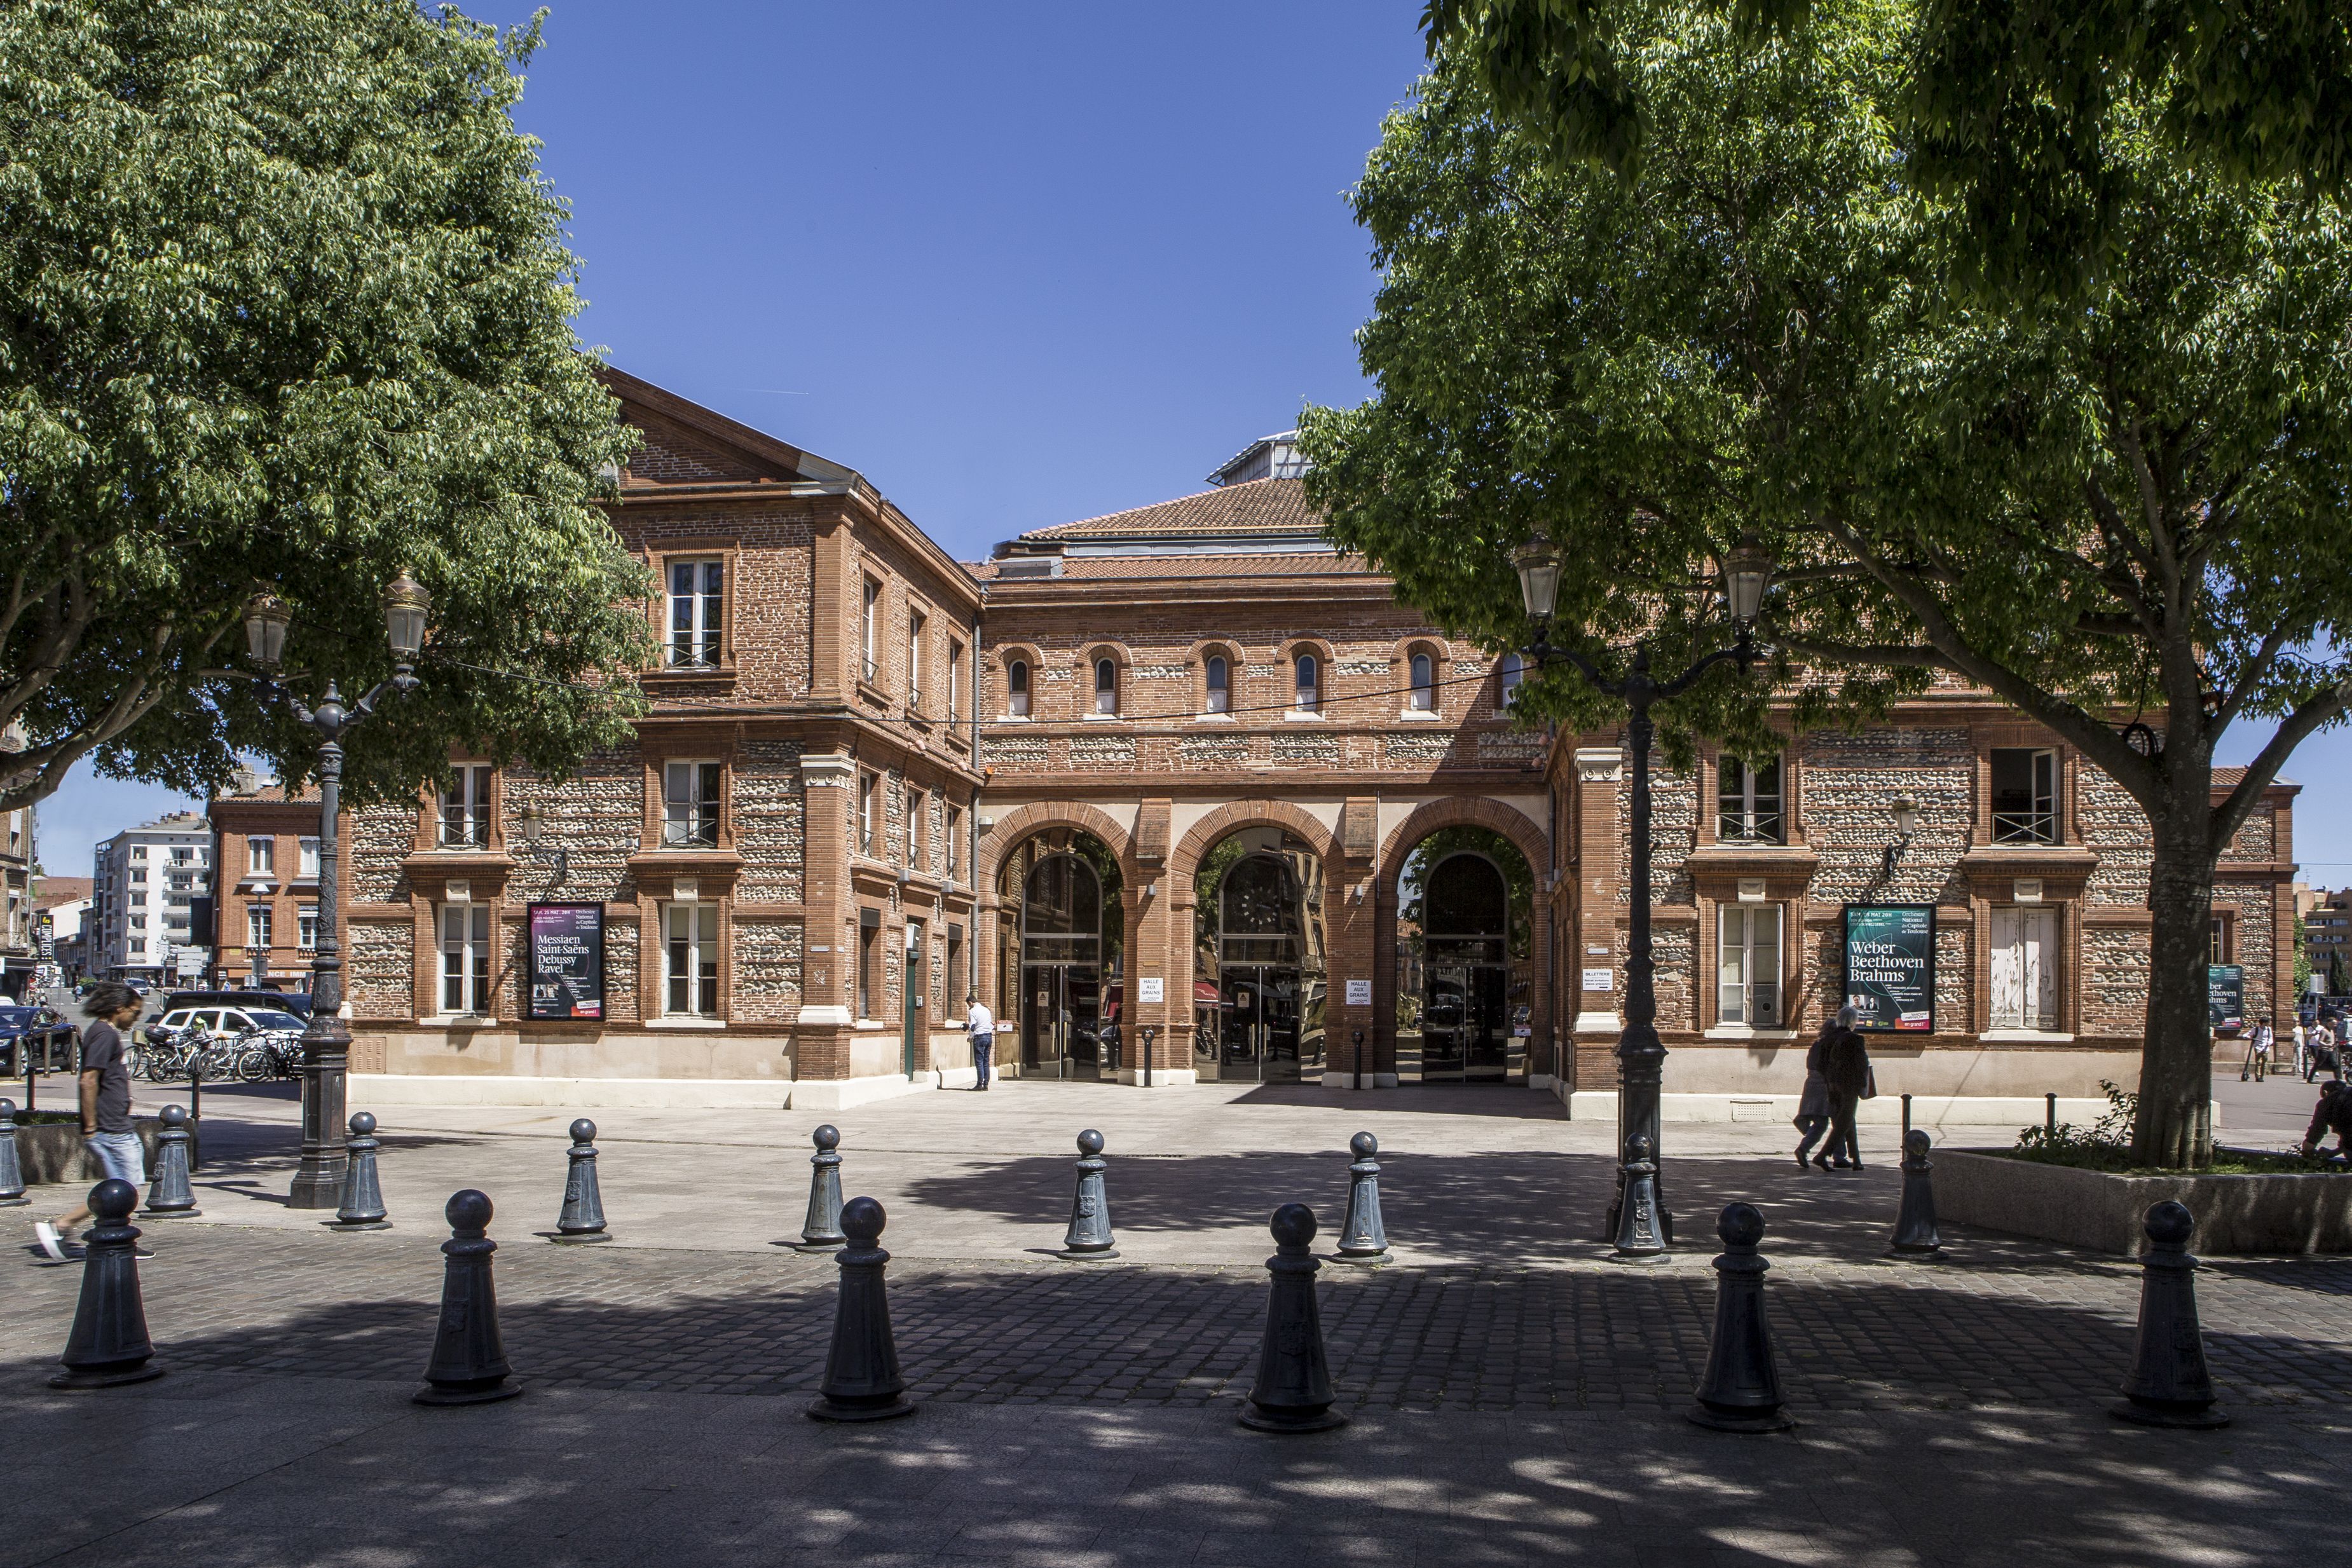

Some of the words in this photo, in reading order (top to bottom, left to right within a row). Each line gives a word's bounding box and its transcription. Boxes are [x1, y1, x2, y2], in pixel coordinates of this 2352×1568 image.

[41, 925, 52, 956] COMPLICES
[538, 934, 580, 944] Messiaen
[537, 944, 589, 954] Saint-Saëns
[1850, 941, 1896, 954] Weber
[538, 955, 577, 966] Debussy
[1850, 955, 1924, 968] Beethoven
[538, 964, 564, 973] Ravel
[1850, 969, 1905, 982] Brahms
